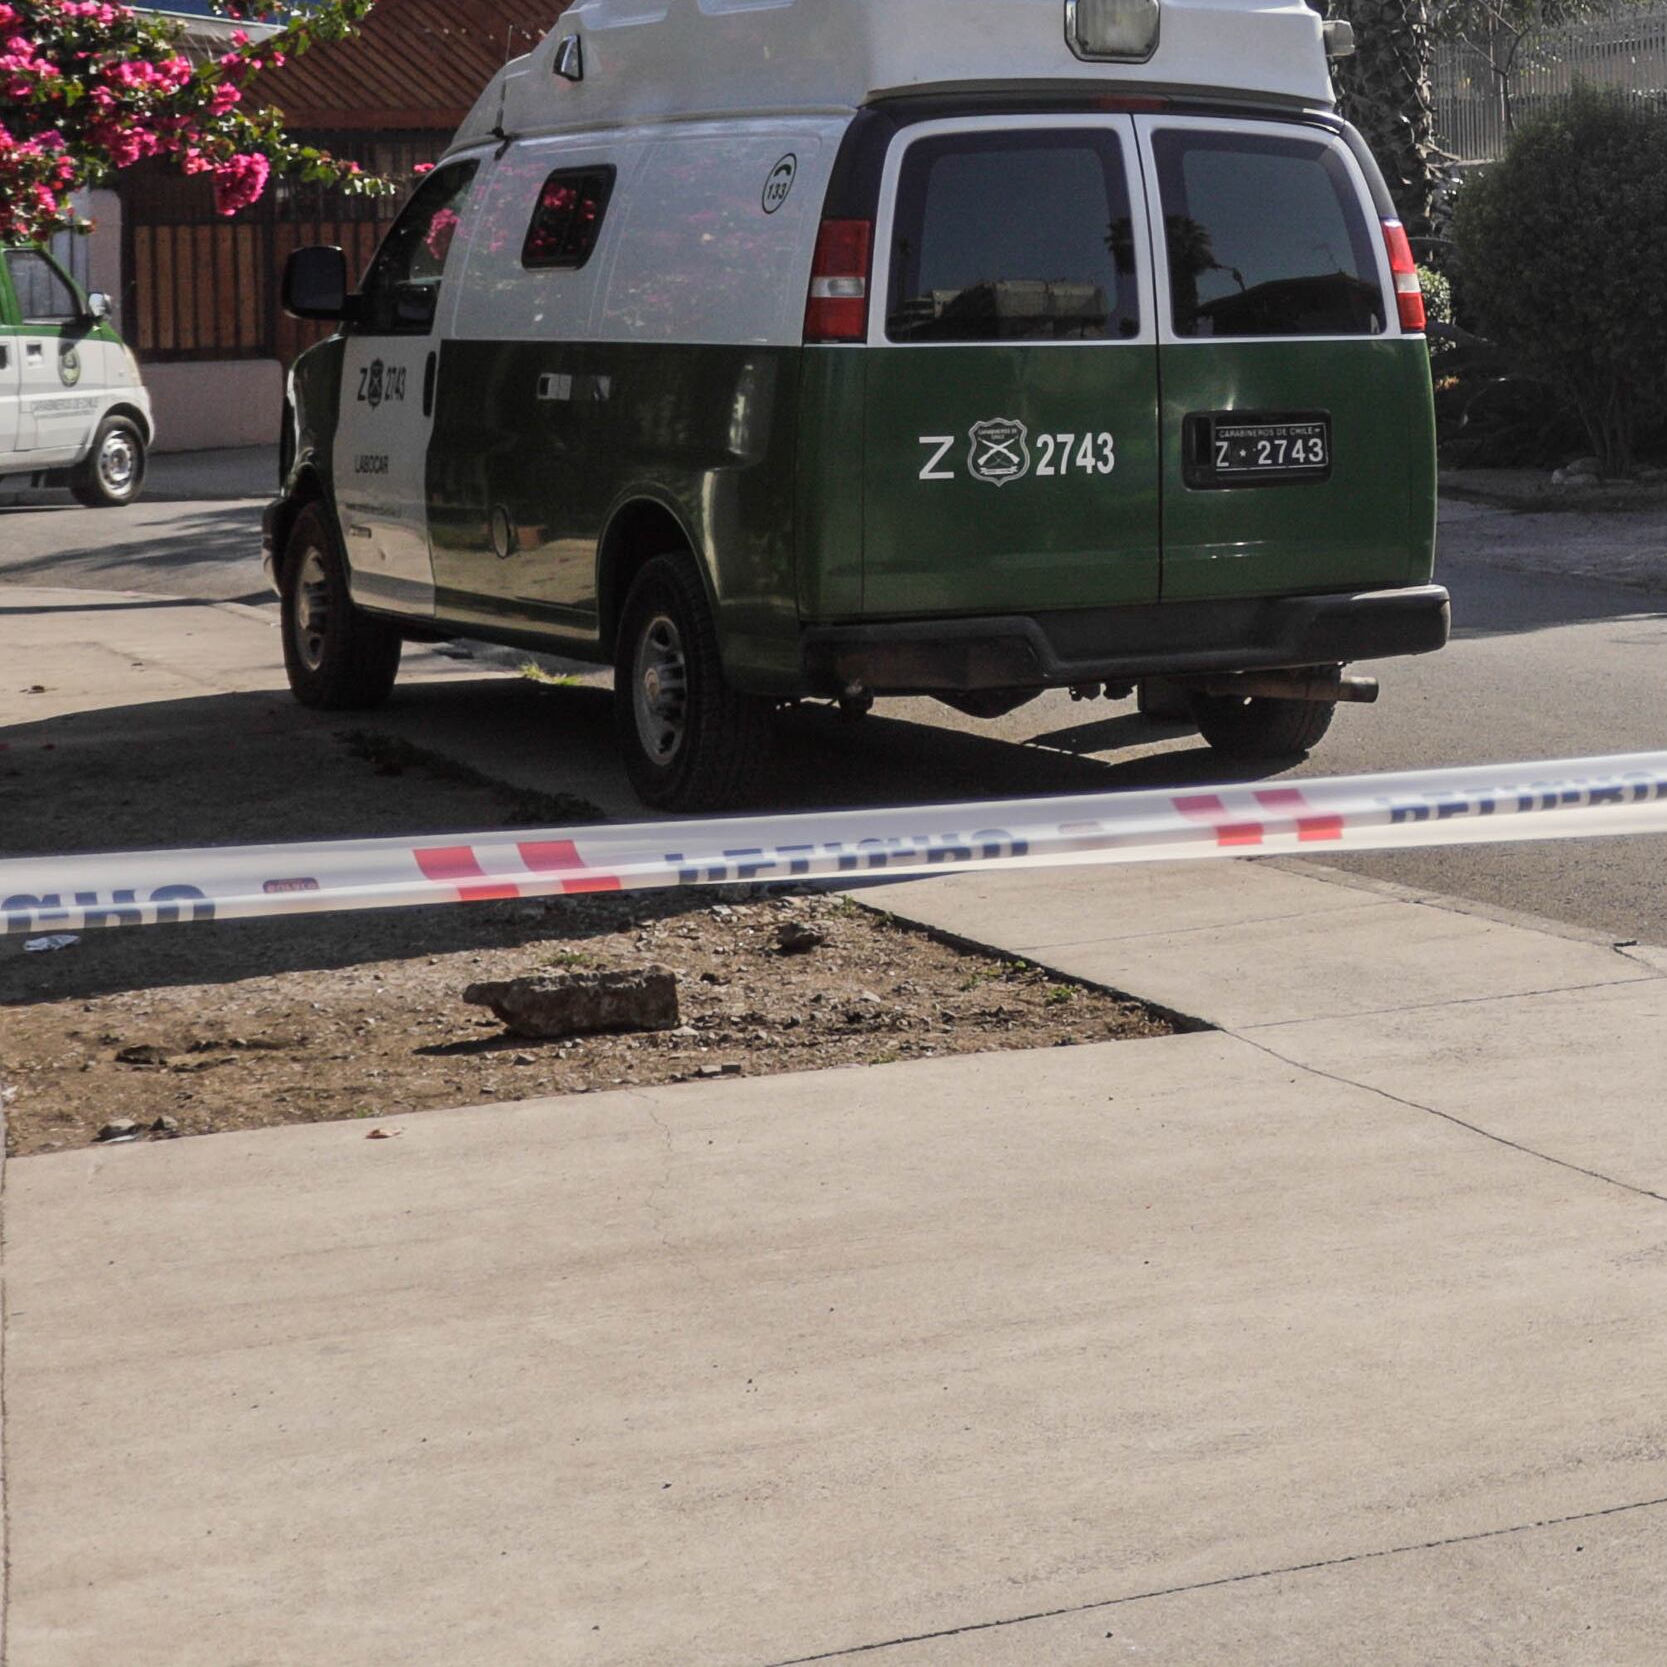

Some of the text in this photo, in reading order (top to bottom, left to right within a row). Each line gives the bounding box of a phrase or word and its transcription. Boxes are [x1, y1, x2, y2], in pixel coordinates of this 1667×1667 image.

[767, 182, 787, 200] 133
[357, 366, 406, 401] Z 2743
[1219, 426, 1312, 438] CARABINEROS DE CHILE
[918, 432, 1115, 479] Z 2743
[1215, 438, 1324, 466] Z 2743
[354, 455, 389, 474] LABOCAR
